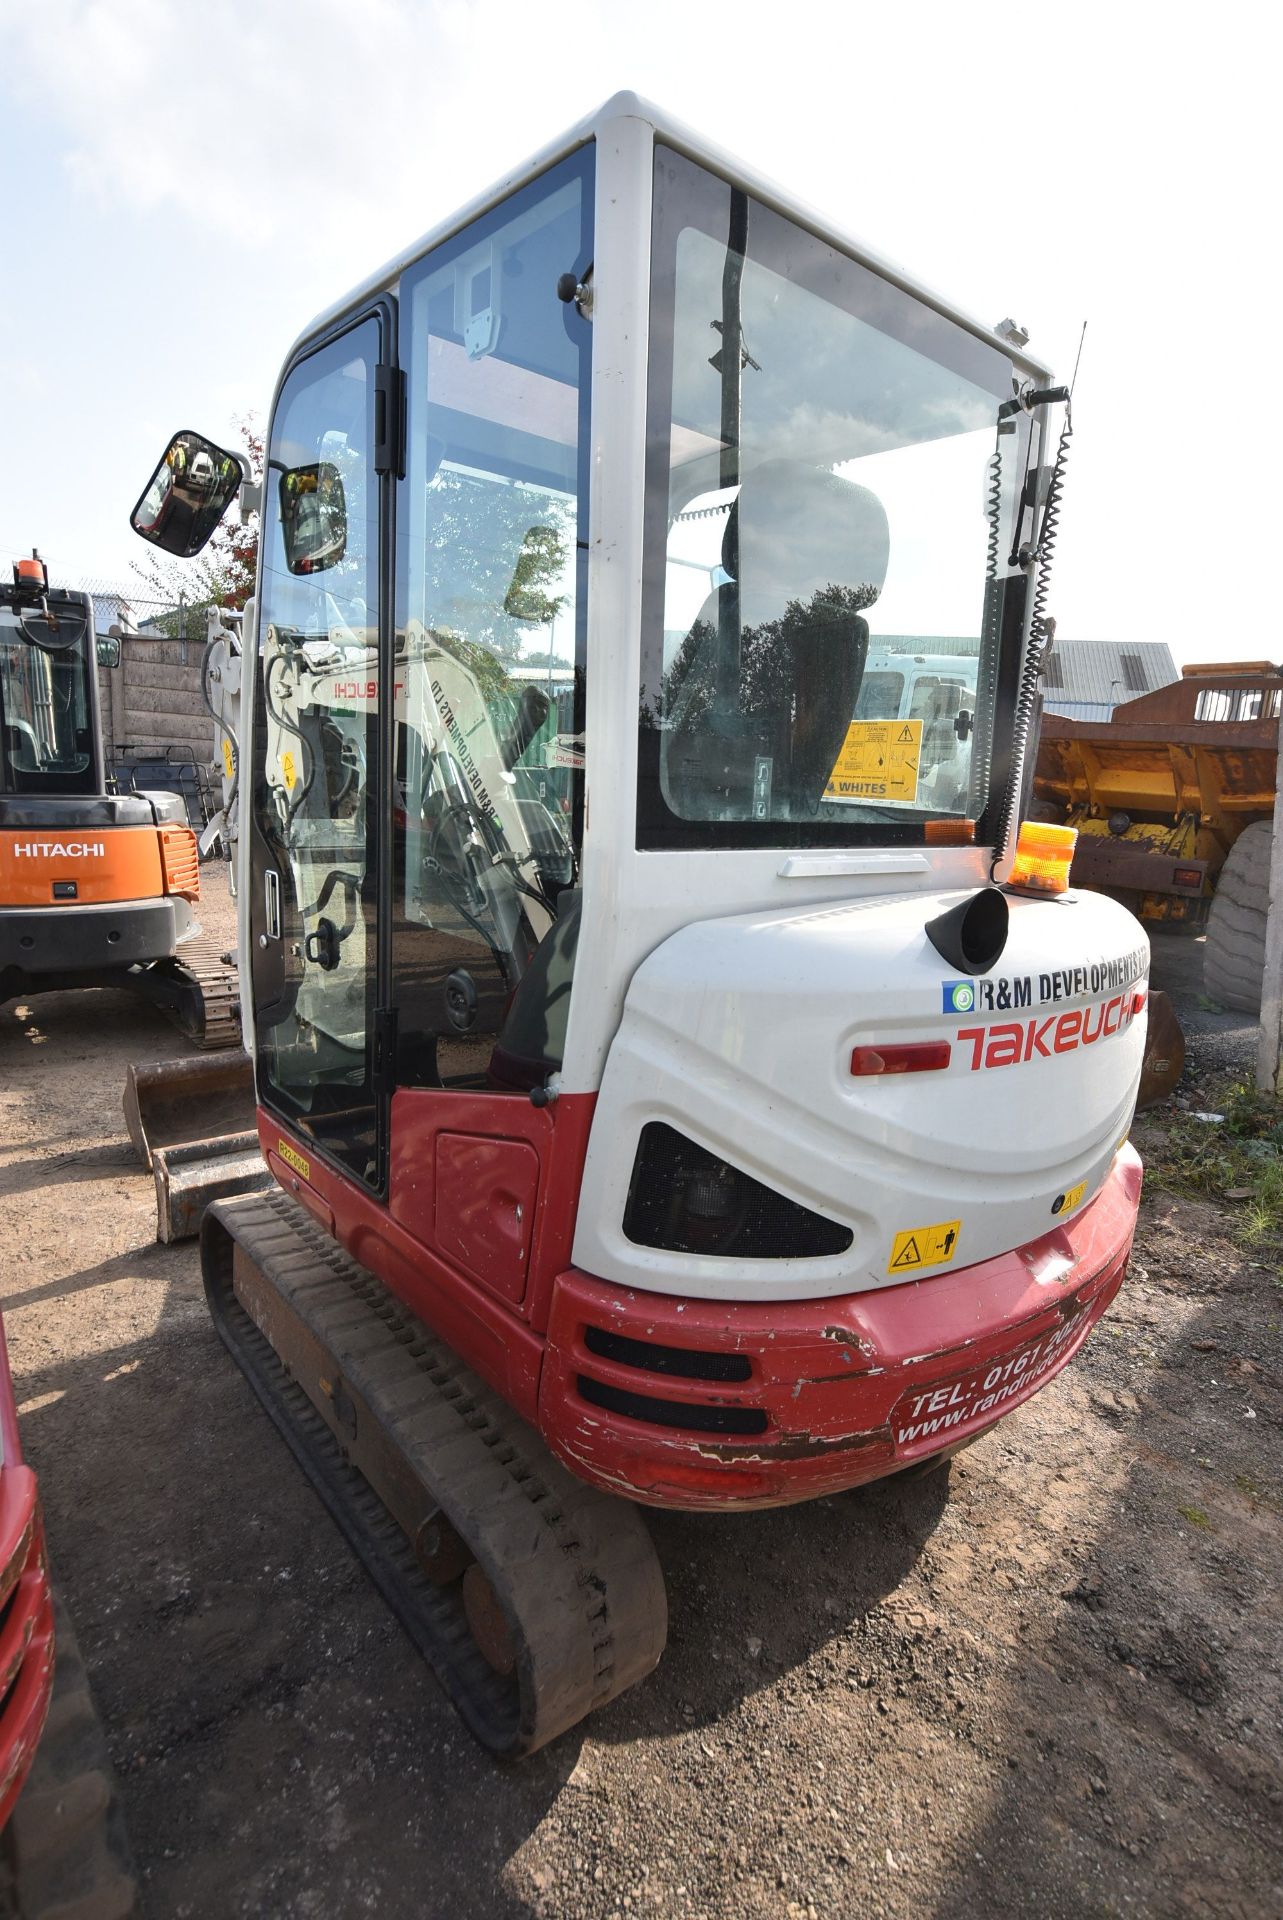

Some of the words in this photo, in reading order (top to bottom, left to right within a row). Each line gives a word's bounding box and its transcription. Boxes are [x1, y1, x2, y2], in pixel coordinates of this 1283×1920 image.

[14, 843, 105, 857] HITACHI
[979, 976, 1032, 1011] R&M
[1039, 952, 1138, 1005] DEVELOPMENTS
[912, 1381, 977, 1418] TEL:
[983, 1343, 1042, 1391] 0161
